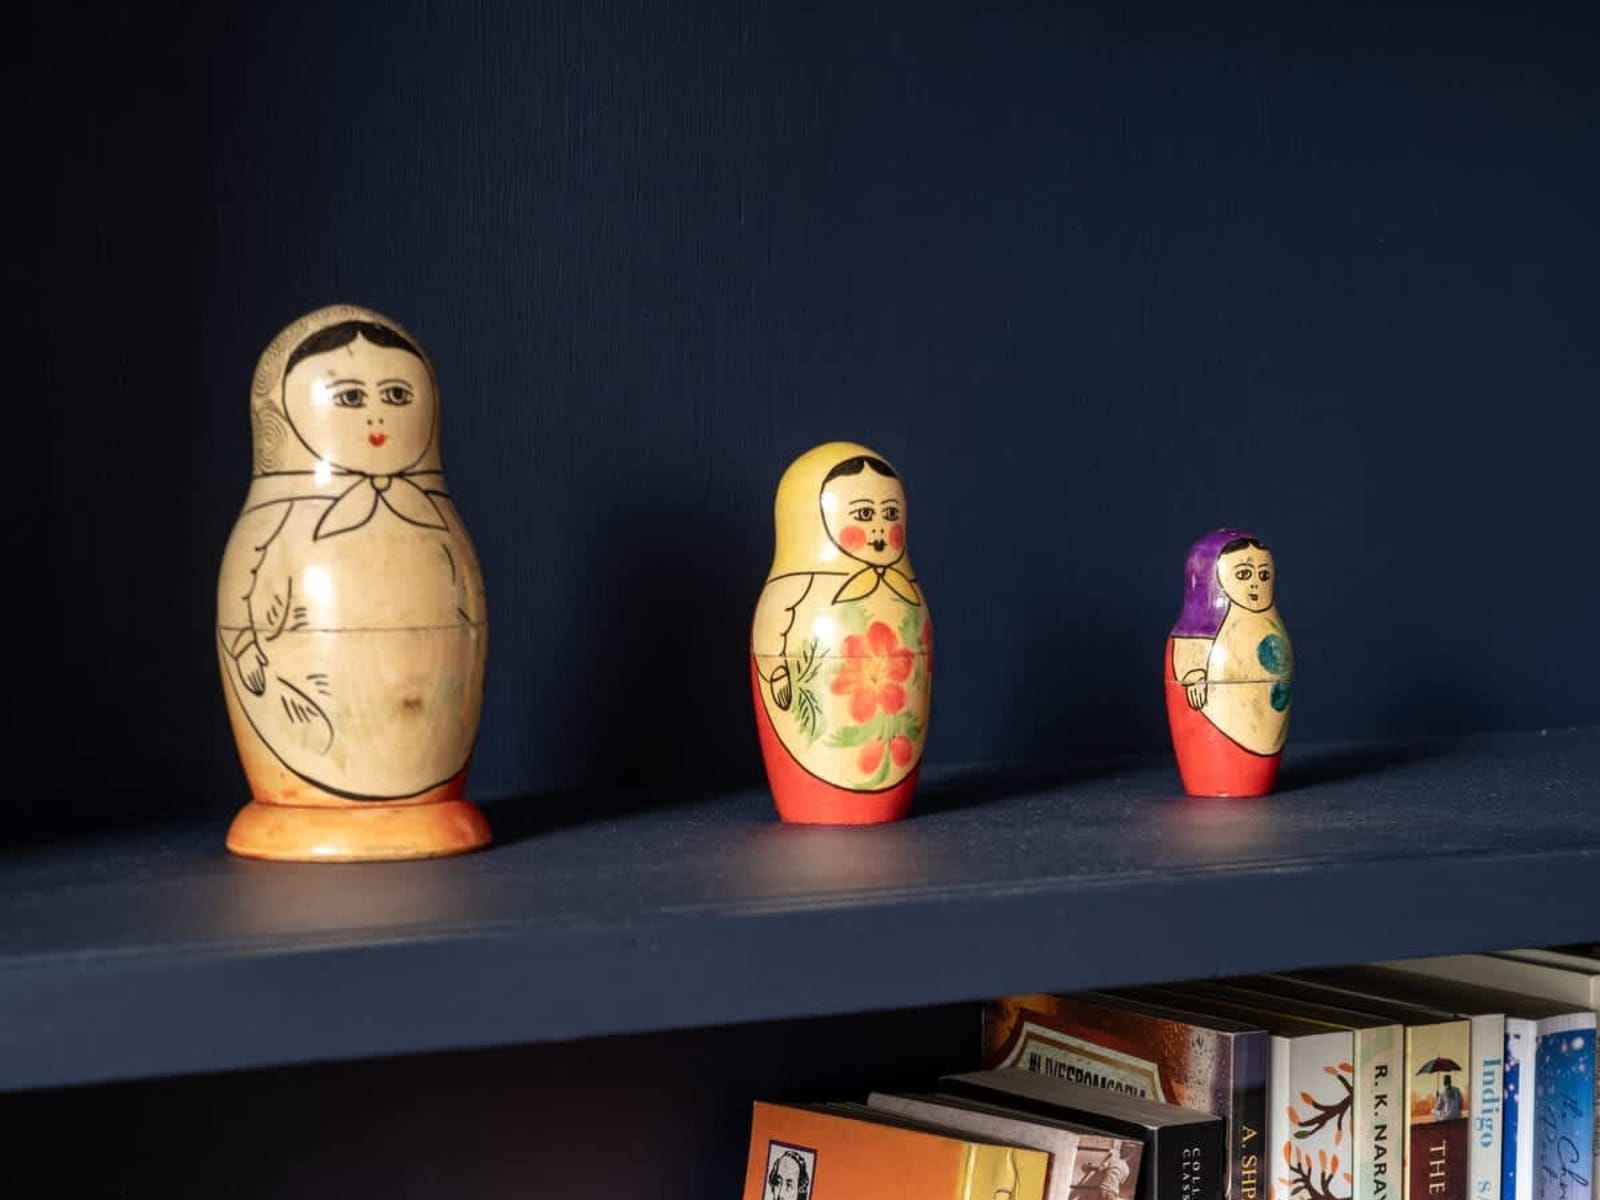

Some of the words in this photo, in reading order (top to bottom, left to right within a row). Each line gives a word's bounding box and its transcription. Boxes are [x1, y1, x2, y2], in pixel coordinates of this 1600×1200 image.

[1375, 1065, 1388, 1086] R.
[1375, 1094, 1387, 1116] K.
[1475, 1058, 1501, 1149] Indigo
[1242, 1126, 1257, 1148] A.
[1429, 1141, 1445, 1193] THE
